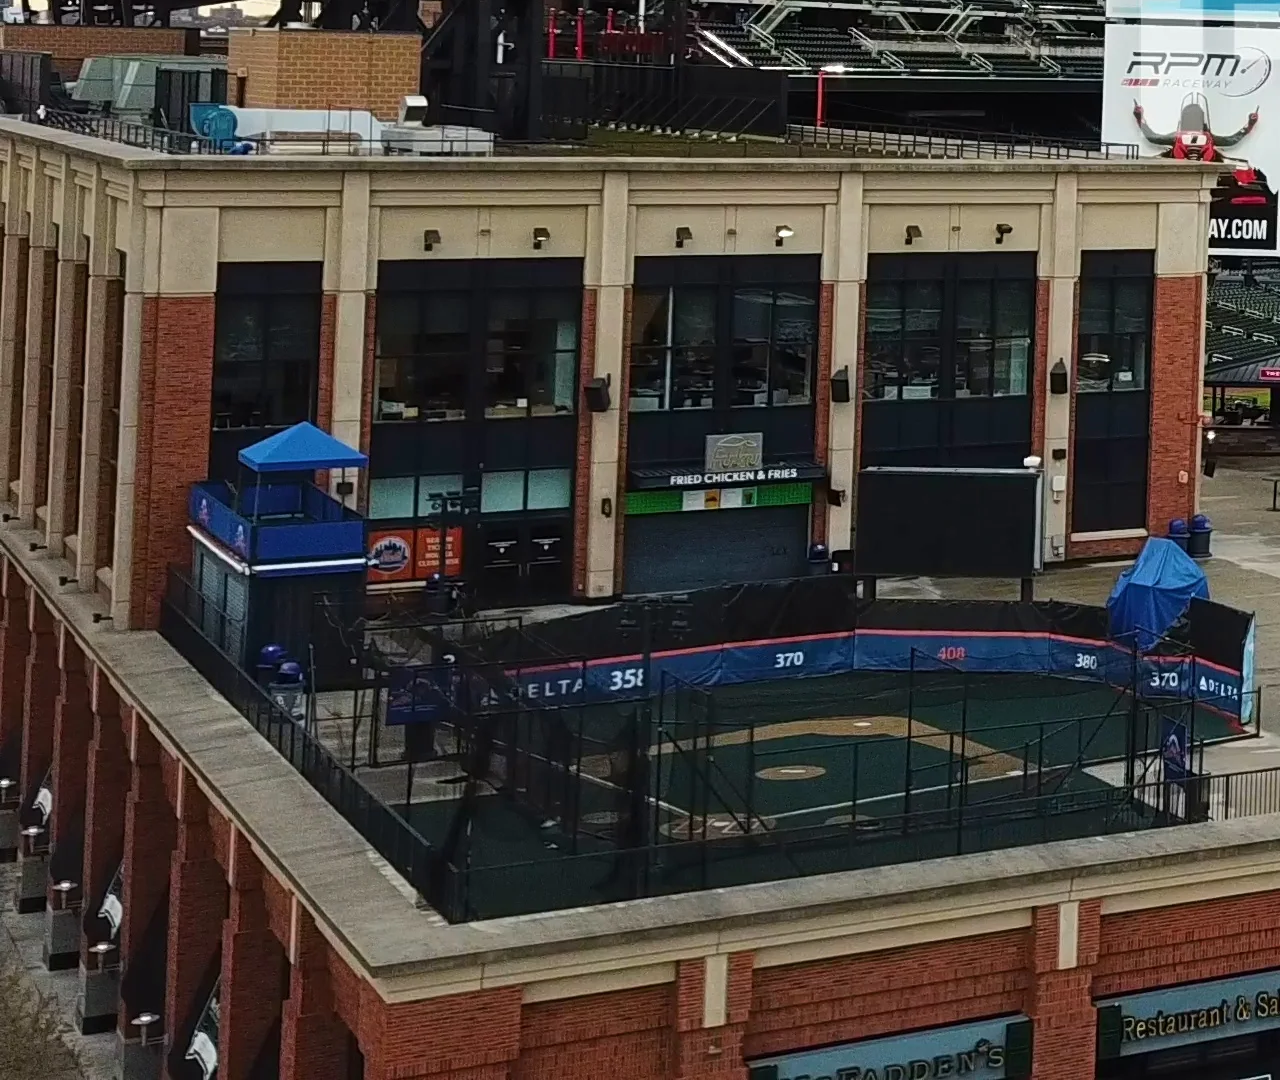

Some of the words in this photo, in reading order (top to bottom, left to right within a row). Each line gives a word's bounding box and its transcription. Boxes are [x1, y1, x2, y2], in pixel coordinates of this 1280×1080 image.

[1126, 51, 1241, 77] RPM
[1162, 78, 1233, 89] RACEWAY
[670, 475, 702, 485] FRIED
[703, 471, 755, 484] CHICKEN
[756, 470, 765, 480] &
[767, 468, 798, 480] FRIES
[773, 651, 805, 669] 370
[936, 645, 966, 661] 408
[1075, 653, 1098, 670] 380
[1150, 672, 1179, 687] 370
[511, 677, 584, 700] ELTA
[1208, 680, 1239, 702] DELTA
[1121, 998, 1231, 1043] Restaurant
[1236, 994, 1251, 1021] &
